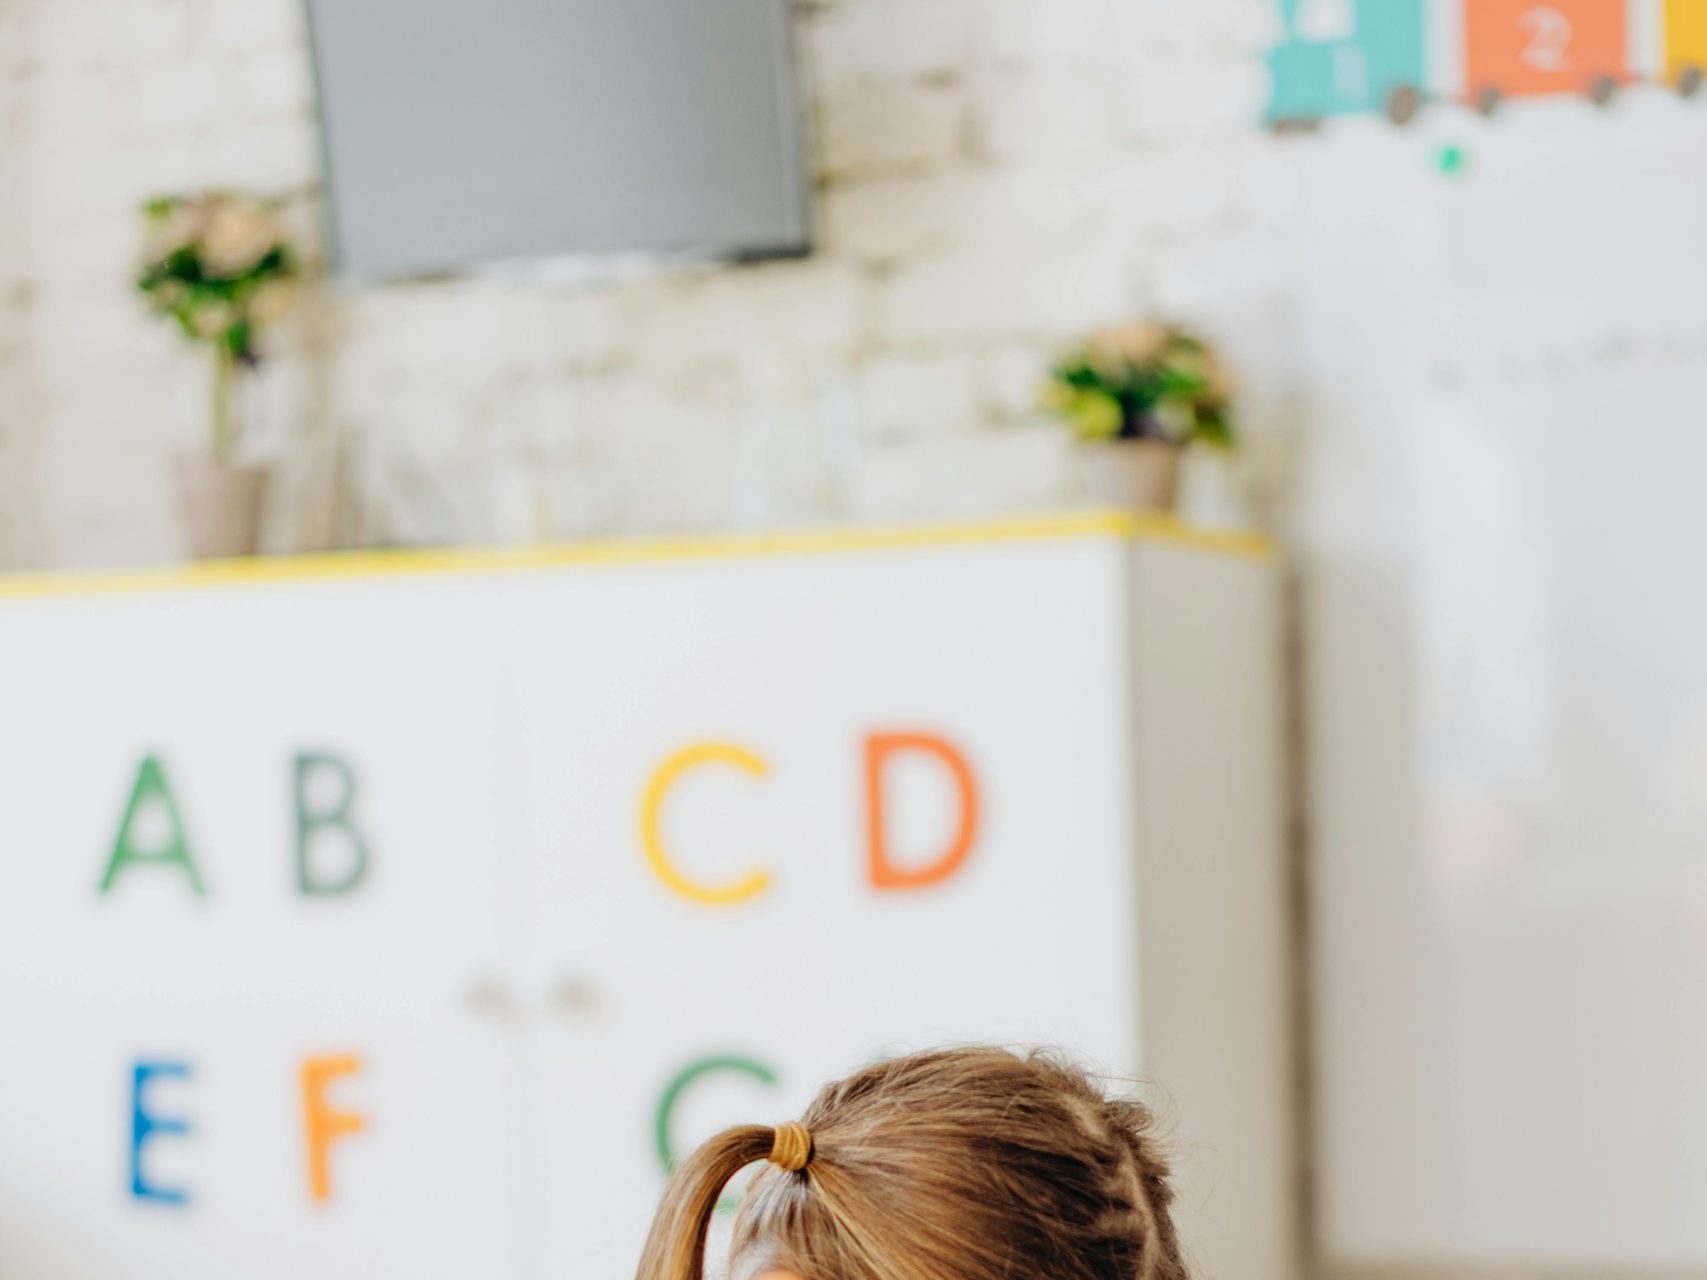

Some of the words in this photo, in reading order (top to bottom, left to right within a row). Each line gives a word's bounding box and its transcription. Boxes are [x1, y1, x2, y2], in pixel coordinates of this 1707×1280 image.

[1520, 8, 1571, 71] 2
[97, 750, 205, 896] A
[289, 749, 371, 898] B
[638, 740, 770, 906] C
[863, 731, 981, 891] D
[128, 1058, 194, 1205] E
[298, 1055, 368, 1203] F
